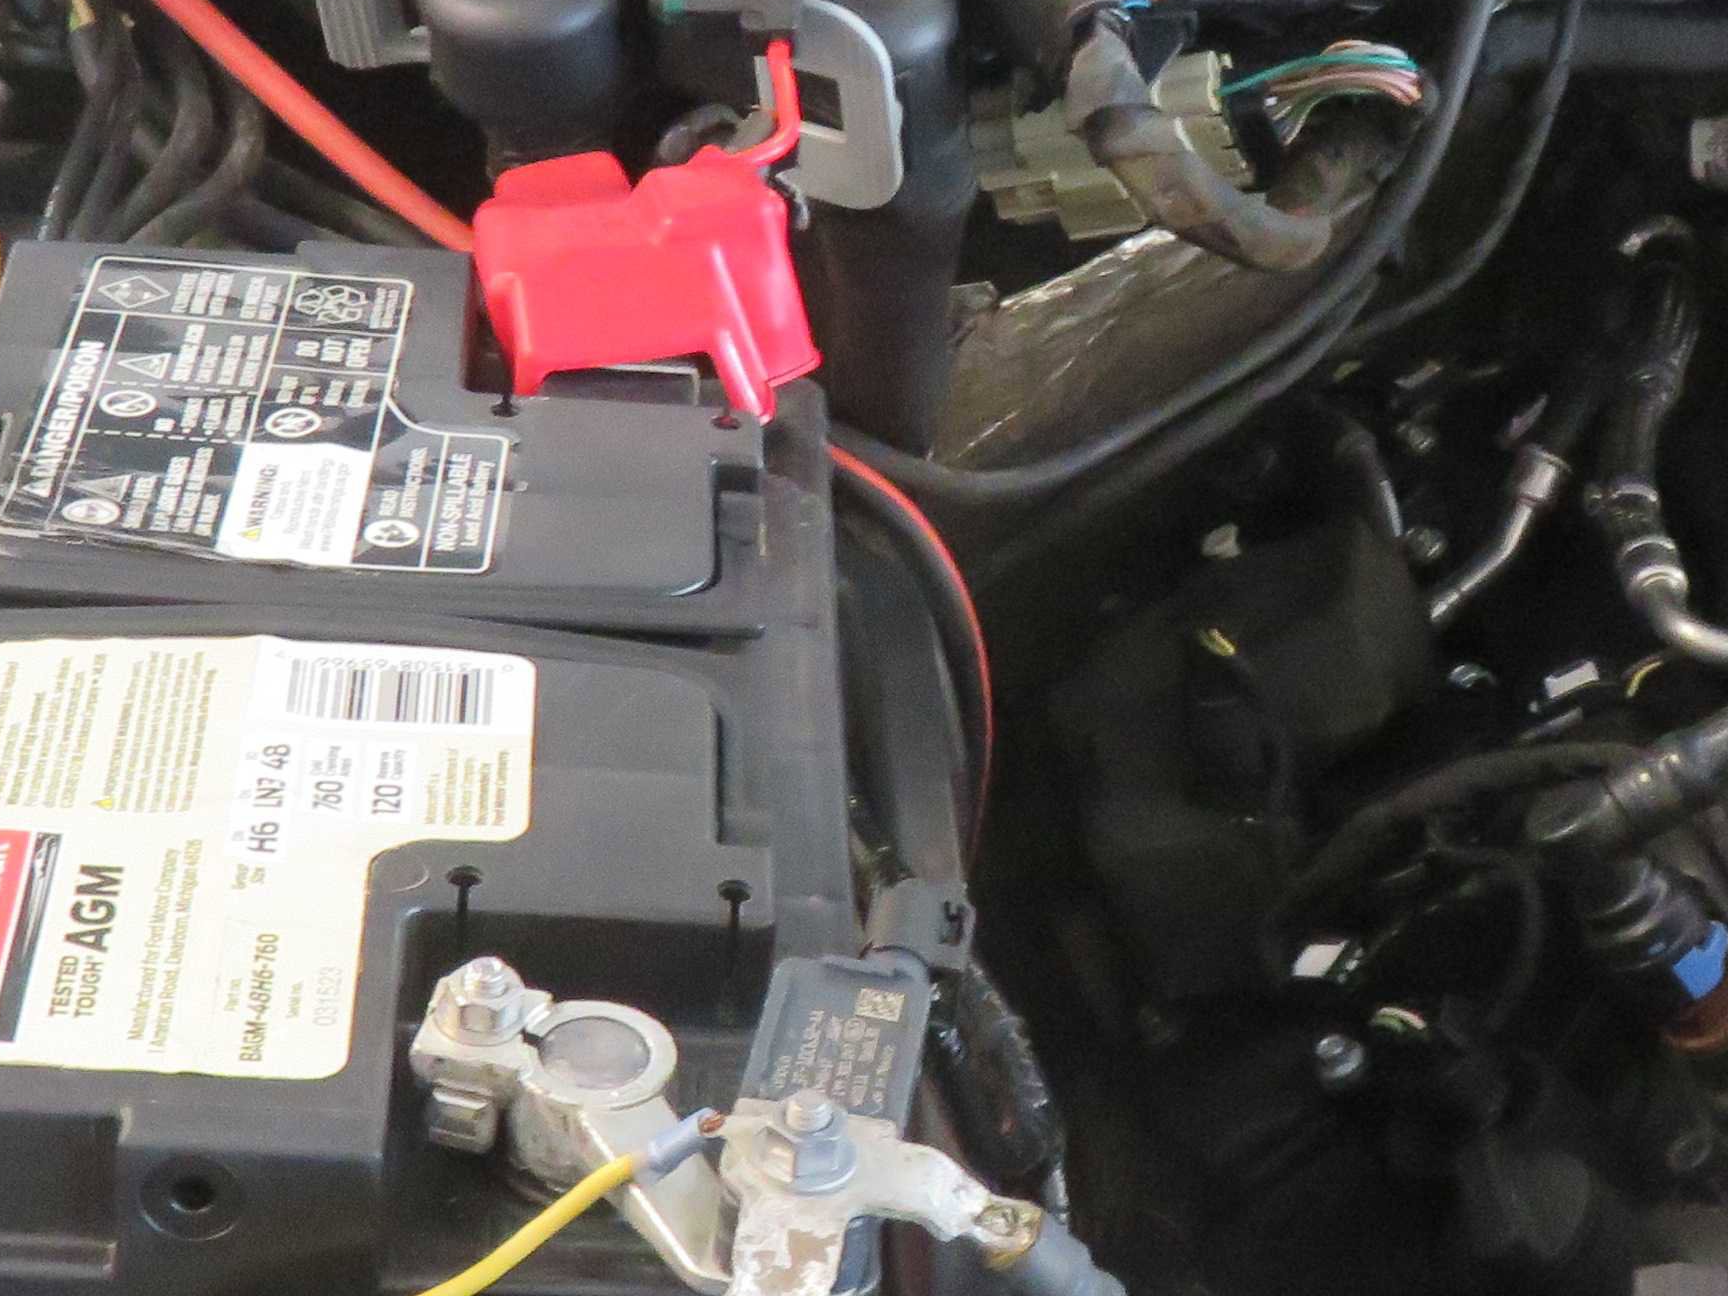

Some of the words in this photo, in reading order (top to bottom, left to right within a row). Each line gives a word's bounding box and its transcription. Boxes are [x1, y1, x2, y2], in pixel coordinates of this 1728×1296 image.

[296, 339, 319, 357] DO
[321, 338, 346, 362] NOT
[347, 337, 371, 368] OPEN
[30, 340, 105, 478] DANGER/POISON
[154, 417, 174, 432] NO
[436, 453, 471, 550] NON-SPILLABLE
[258, 742, 291, 769] 48
[252, 776, 286, 808] LN3
[310, 779, 344, 811] 760
[369, 783, 404, 815] 120
[245, 820, 280, 853] H6
[153, 847, 182, 893] Company
[61, 864, 124, 952] AGM
[149, 895, 171, 922] Motor
[144, 925, 164, 947] Ford
[140, 949, 160, 964] for
[149, 1001, 174, 1046] American
[173, 867, 201, 912] Michigan
[48, 955, 78, 1016] TESTED
[237, 933, 279, 1061] BAGM-48H6-760
[125, 966, 157, 1040] Manufactured
